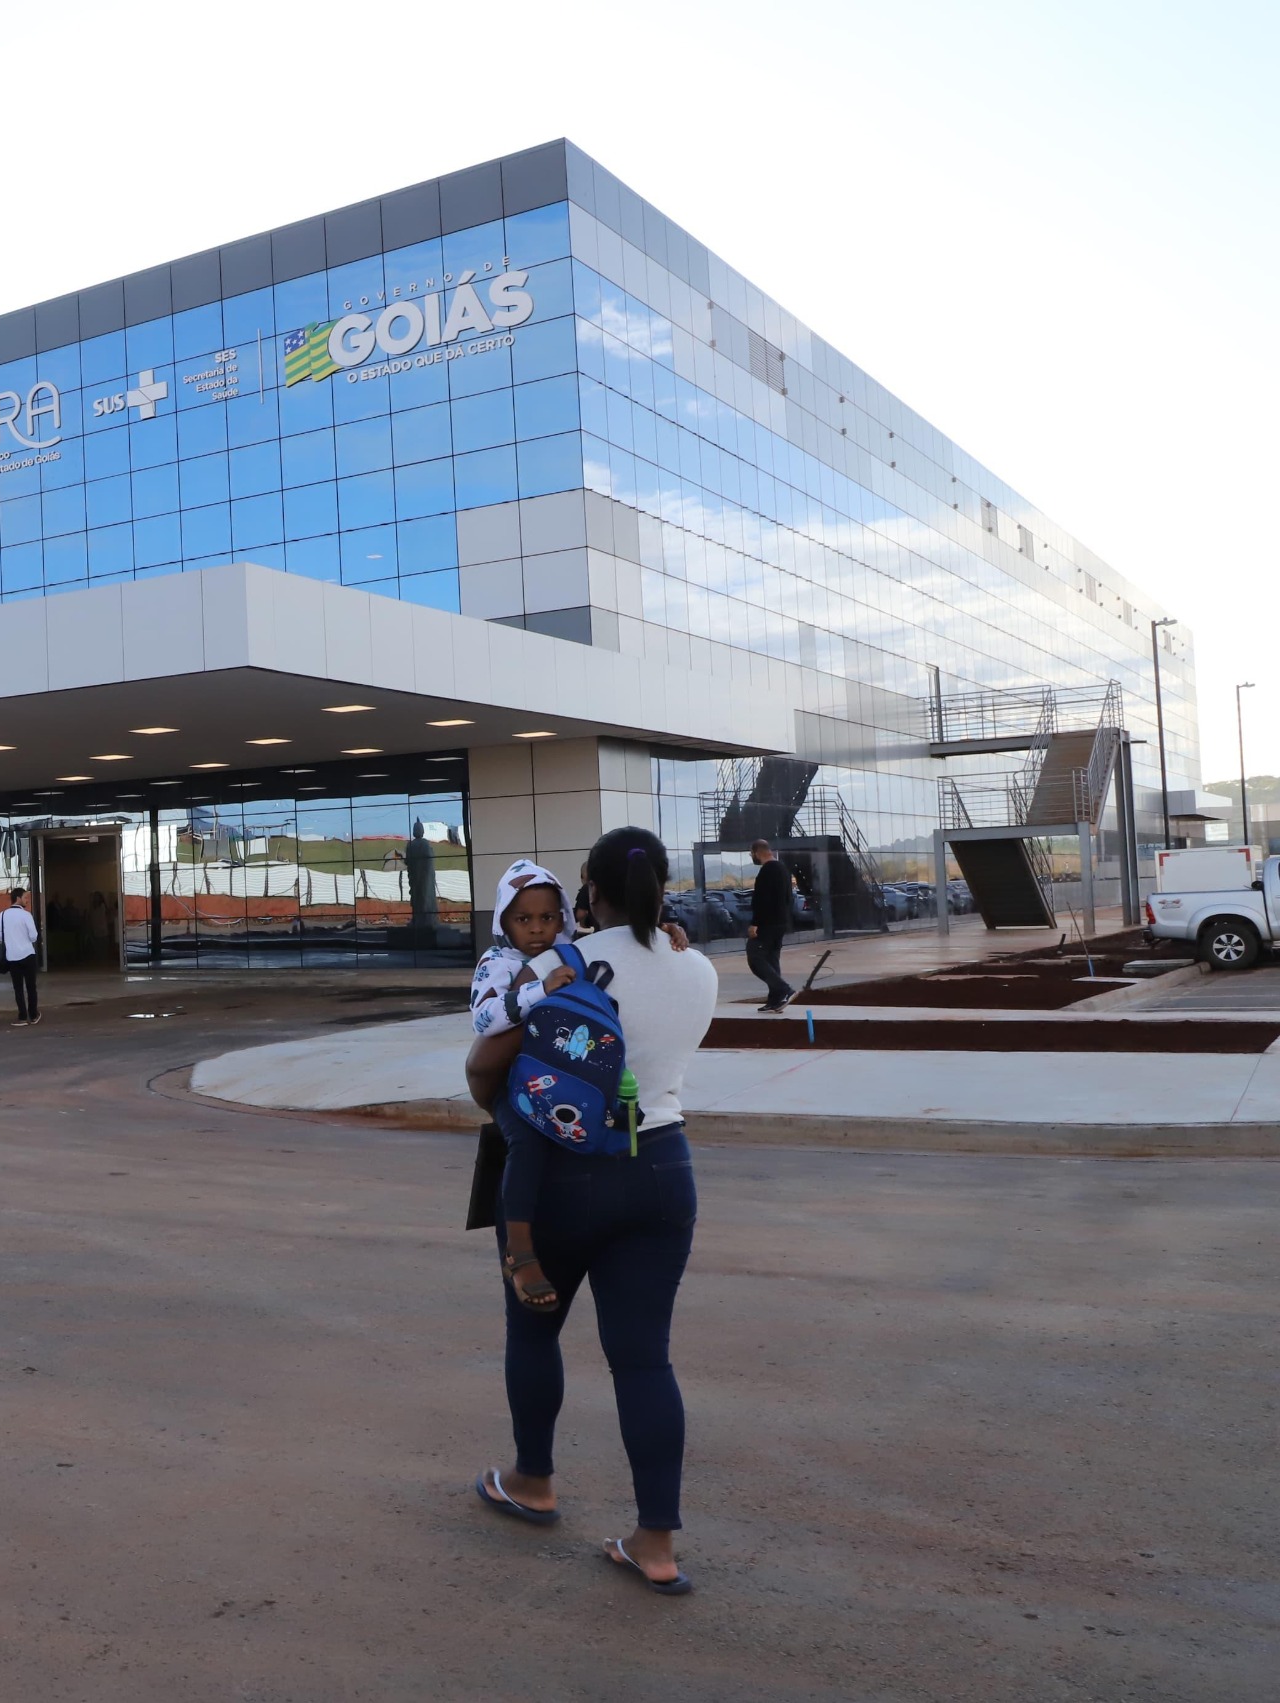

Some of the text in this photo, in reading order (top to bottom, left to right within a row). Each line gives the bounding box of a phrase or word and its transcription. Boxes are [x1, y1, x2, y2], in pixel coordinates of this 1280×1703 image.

[343, 256, 510, 310] GOVERNO DE
[328, 270, 534, 367] GOIÁS
[215, 350, 237, 363] SES
[347, 334, 515, 383] O ESTADO QUE DÁ CERTO
[183, 364, 238, 384] Secretaria de
[196, 376, 238, 392] Estado da
[212, 387, 239, 400] Saúde
[93, 393, 126, 417] SUS
[21, 457, 35, 468] de
[35, 450, 61, 464] Goiás
